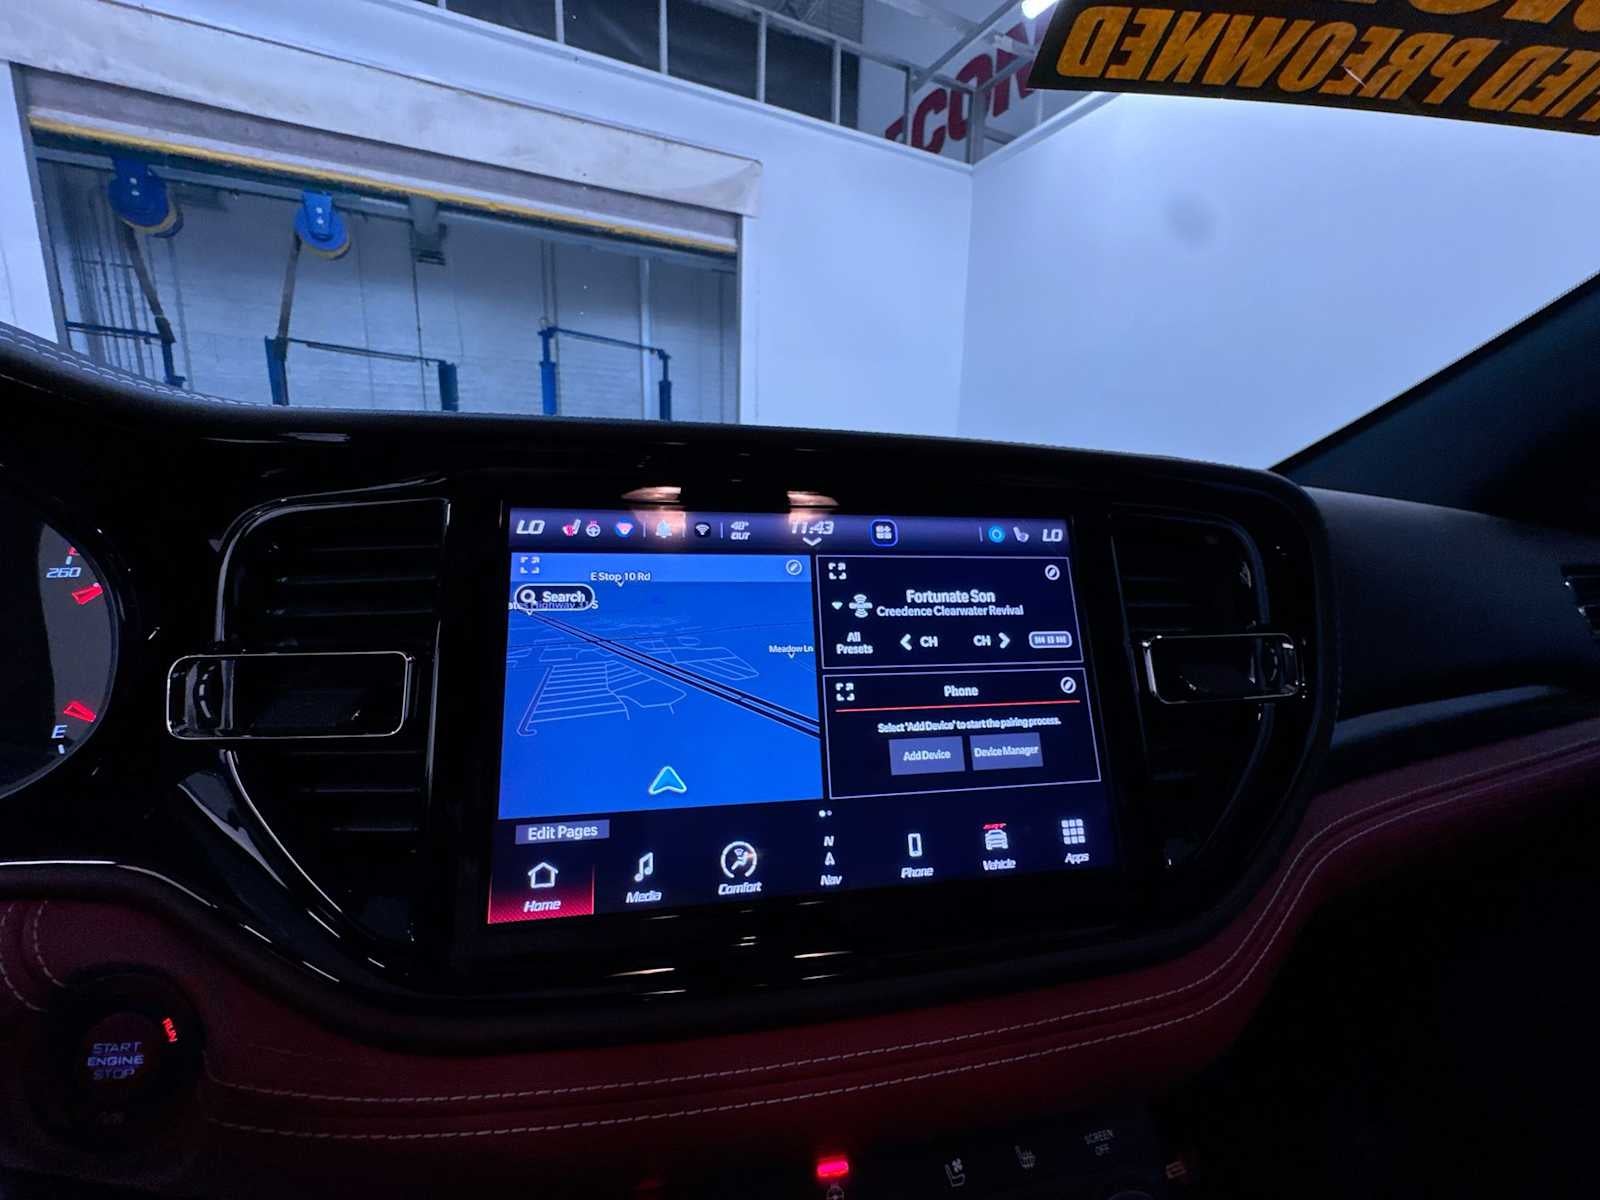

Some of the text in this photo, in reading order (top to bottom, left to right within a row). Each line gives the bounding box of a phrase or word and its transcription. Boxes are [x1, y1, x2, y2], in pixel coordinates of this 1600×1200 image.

[516, 520, 545, 535] LO
[791, 519, 834, 535] 11:43
[730, 532, 751, 540] OUT
[1042, 528, 1063, 542] LO
[46, 567, 81, 578] 260
[591, 571, 651, 583] E Stop 10 Rd
[542, 590, 586, 602] Search
[906, 589, 996, 603] Fortunate Son
[876, 605, 1024, 617] Creedence Clearwater Revival
[847, 632, 861, 643] All
[920, 636, 938, 648] CH
[973, 635, 991, 647] CH
[768, 645, 814, 653] Meadow Ln
[836, 644, 873, 655] Presets
[944, 685, 979, 697] Phone
[878, 722, 905, 733] Select
[957, 720, 965, 730] to
[965, 720, 985, 730] start
[985, 718, 1000, 729] the
[1000, 717, 1028, 730] pairing
[1028, 717, 1062, 727] process.
[51, 725, 67, 739] E
[903, 749, 951, 761] Add Device
[974, 745, 1039, 758] Device Manager
[528, 824, 598, 840] Edit Pages
[823, 835, 834, 847] N
[1065, 852, 1089, 864] Apps
[983, 858, 1016, 871] Vehicle
[901, 866, 934, 879] Phone
[820, 874, 842, 886] Nav
[718, 882, 762, 895] Comfort
[625, 890, 662, 903] Media
[523, 900, 561, 912] Home
[92, 1041, 143, 1054] START
[87, 1055, 144, 1067] ENGINE
[93, 1067, 135, 1080] STOP
[1084, 1129, 1115, 1145] SCREEN
